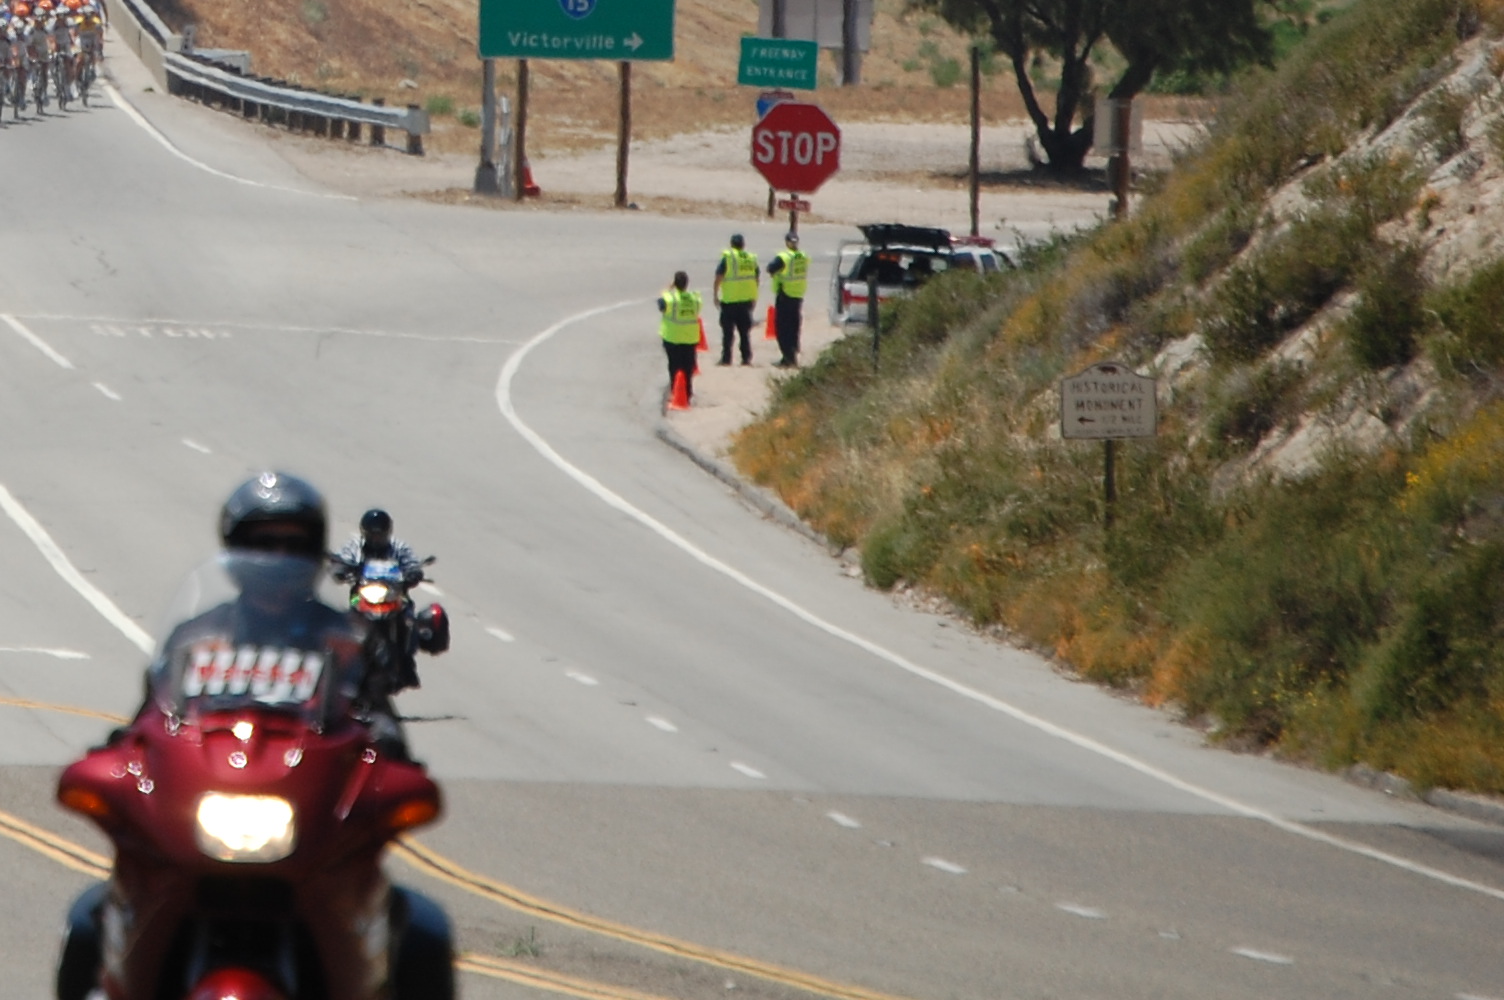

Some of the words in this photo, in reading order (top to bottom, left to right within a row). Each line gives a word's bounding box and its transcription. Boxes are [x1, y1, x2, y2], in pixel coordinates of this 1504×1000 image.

[508, 32, 615, 49] Victorville
[752, 48, 806, 60] FREEWAY
[747, 66, 808, 80] ENTRANCE
[756, 131, 836, 166] STOP
[1072, 382, 1145, 394] HISTORICAL
[1075, 399, 1143, 411] MONUMENT
